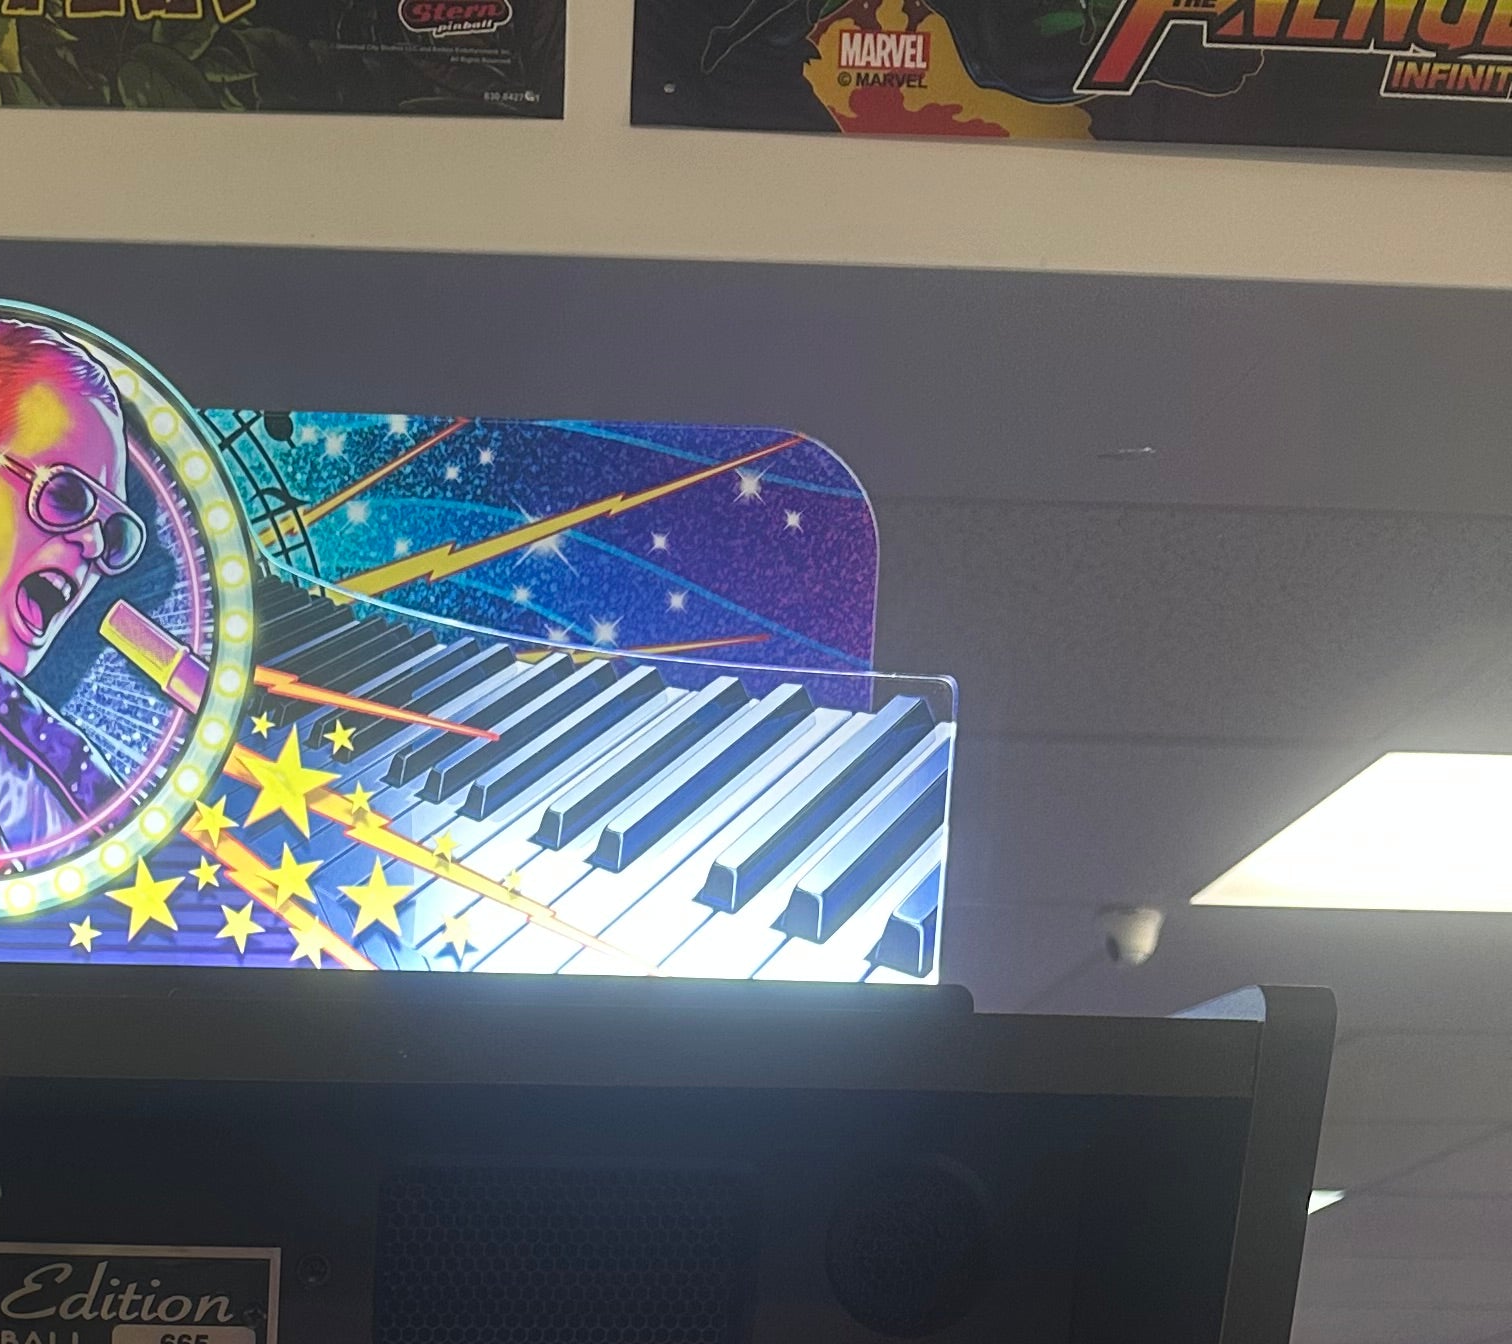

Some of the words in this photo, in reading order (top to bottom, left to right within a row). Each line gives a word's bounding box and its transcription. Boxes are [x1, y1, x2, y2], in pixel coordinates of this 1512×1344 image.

[412, 2, 497, 21] Stern
[438, 19, 493, 33] pinball
[840, 32, 928, 69] MARVEL
[856, 72, 928, 88] MARVEL
[0, 1262, 234, 1323] Edition
